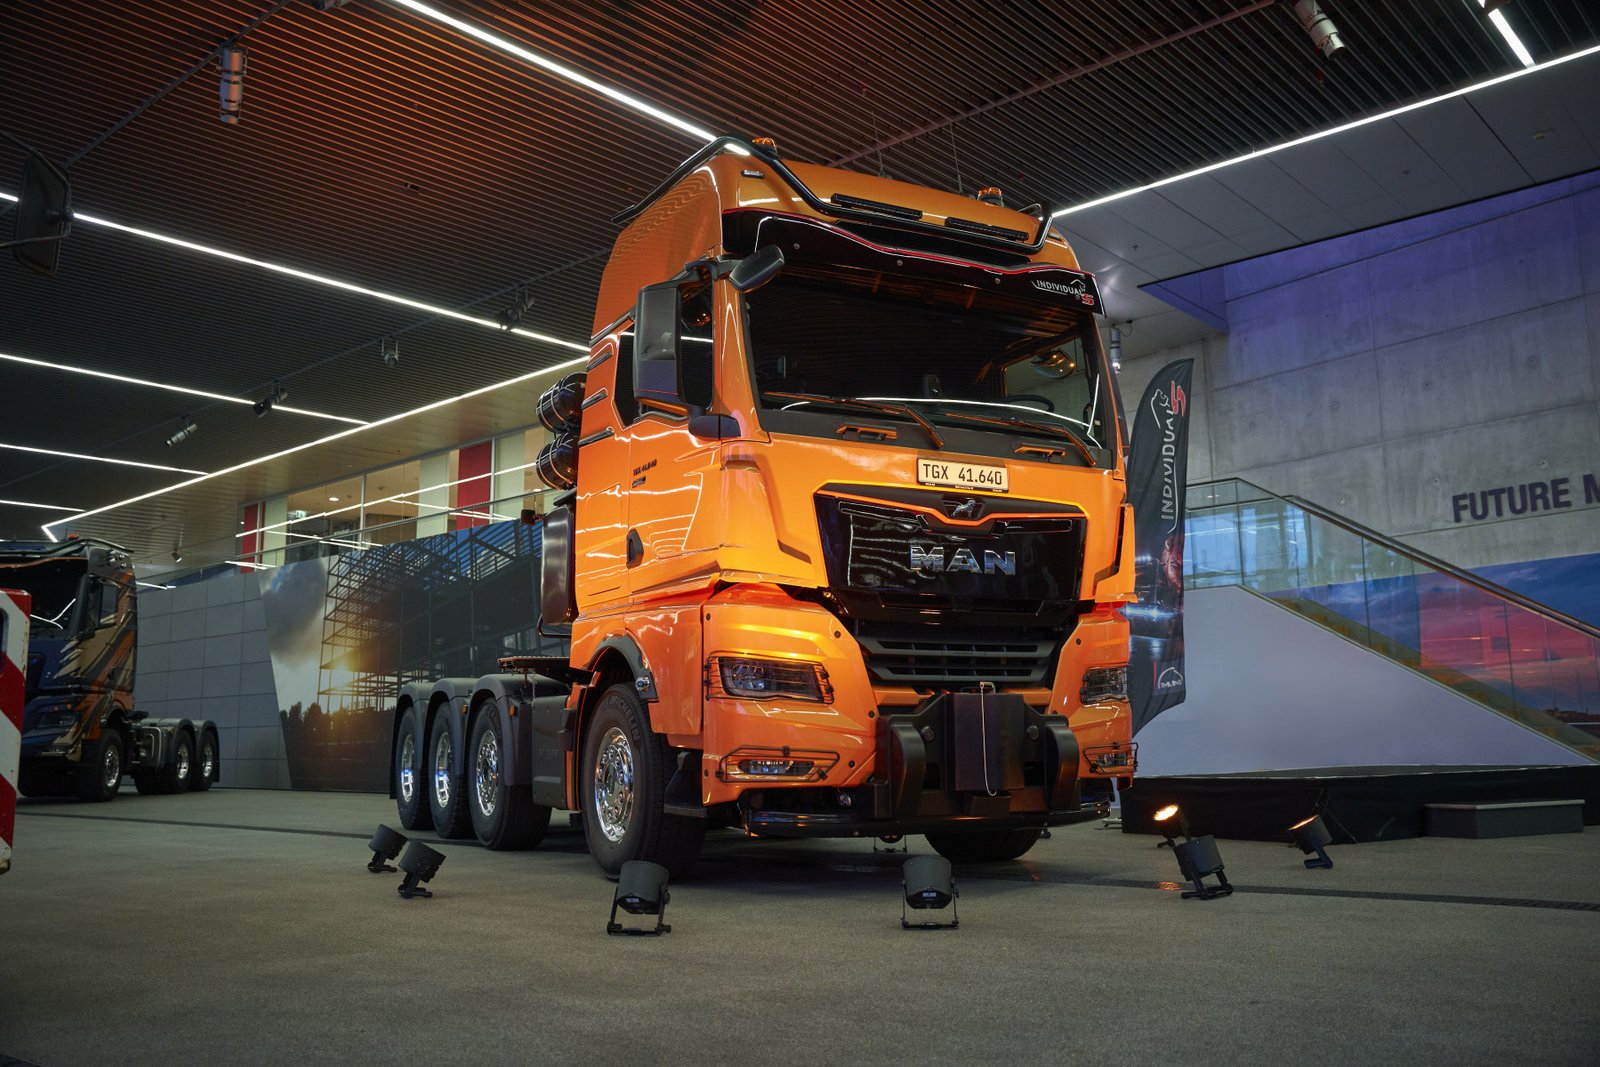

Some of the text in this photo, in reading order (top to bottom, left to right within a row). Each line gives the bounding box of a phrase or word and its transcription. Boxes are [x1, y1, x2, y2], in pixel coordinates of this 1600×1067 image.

[1036, 279, 1084, 297] INDIVIDUAL
[923, 463, 1003, 485] TGX 41.640
[1161, 409, 1175, 520] INDIVIDUAL
[1452, 477, 1572, 523] FUTURE
[910, 545, 1016, 575] MAN
